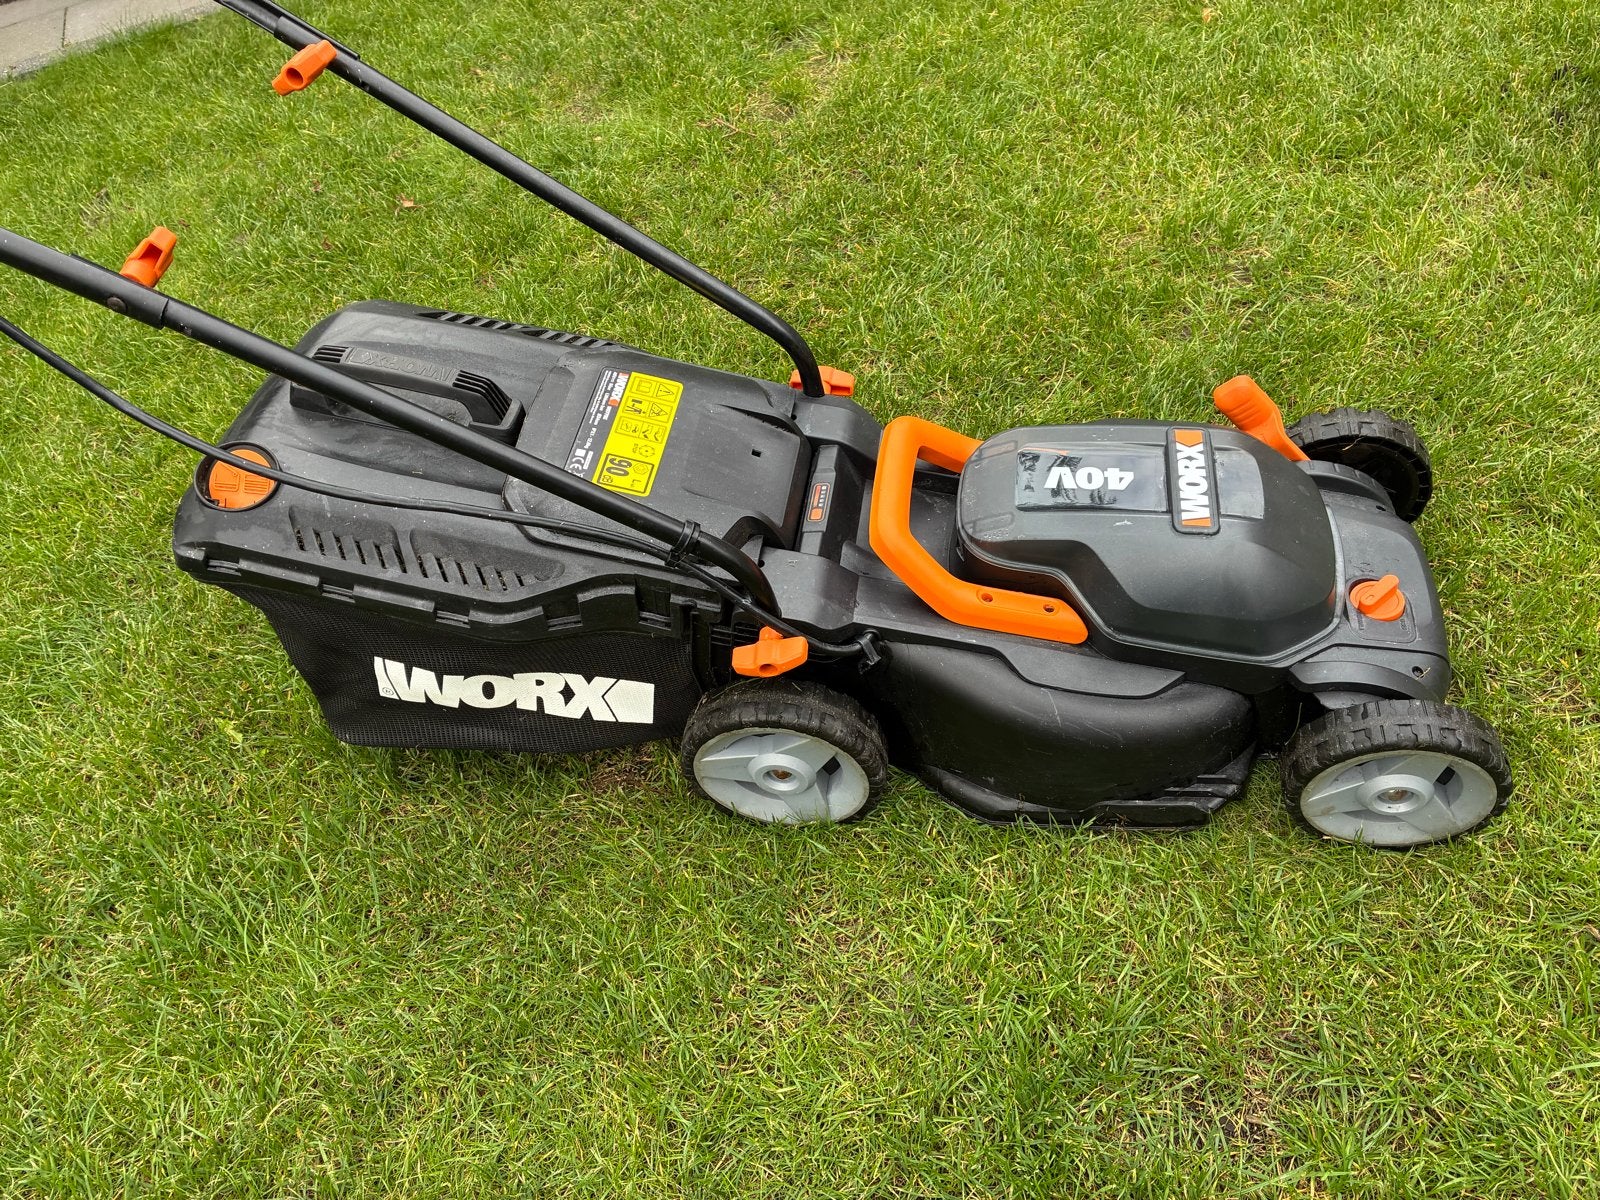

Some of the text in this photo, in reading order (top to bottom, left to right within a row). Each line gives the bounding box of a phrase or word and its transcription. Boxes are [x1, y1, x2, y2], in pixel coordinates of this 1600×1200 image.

[363, 351, 451, 382] WORX
[610, 374, 628, 400] WORX
[606, 457, 632, 477] 90
[1043, 466, 1135, 491] 40V
[1176, 442, 1210, 520] WORX
[385, 657, 618, 722] WORX
